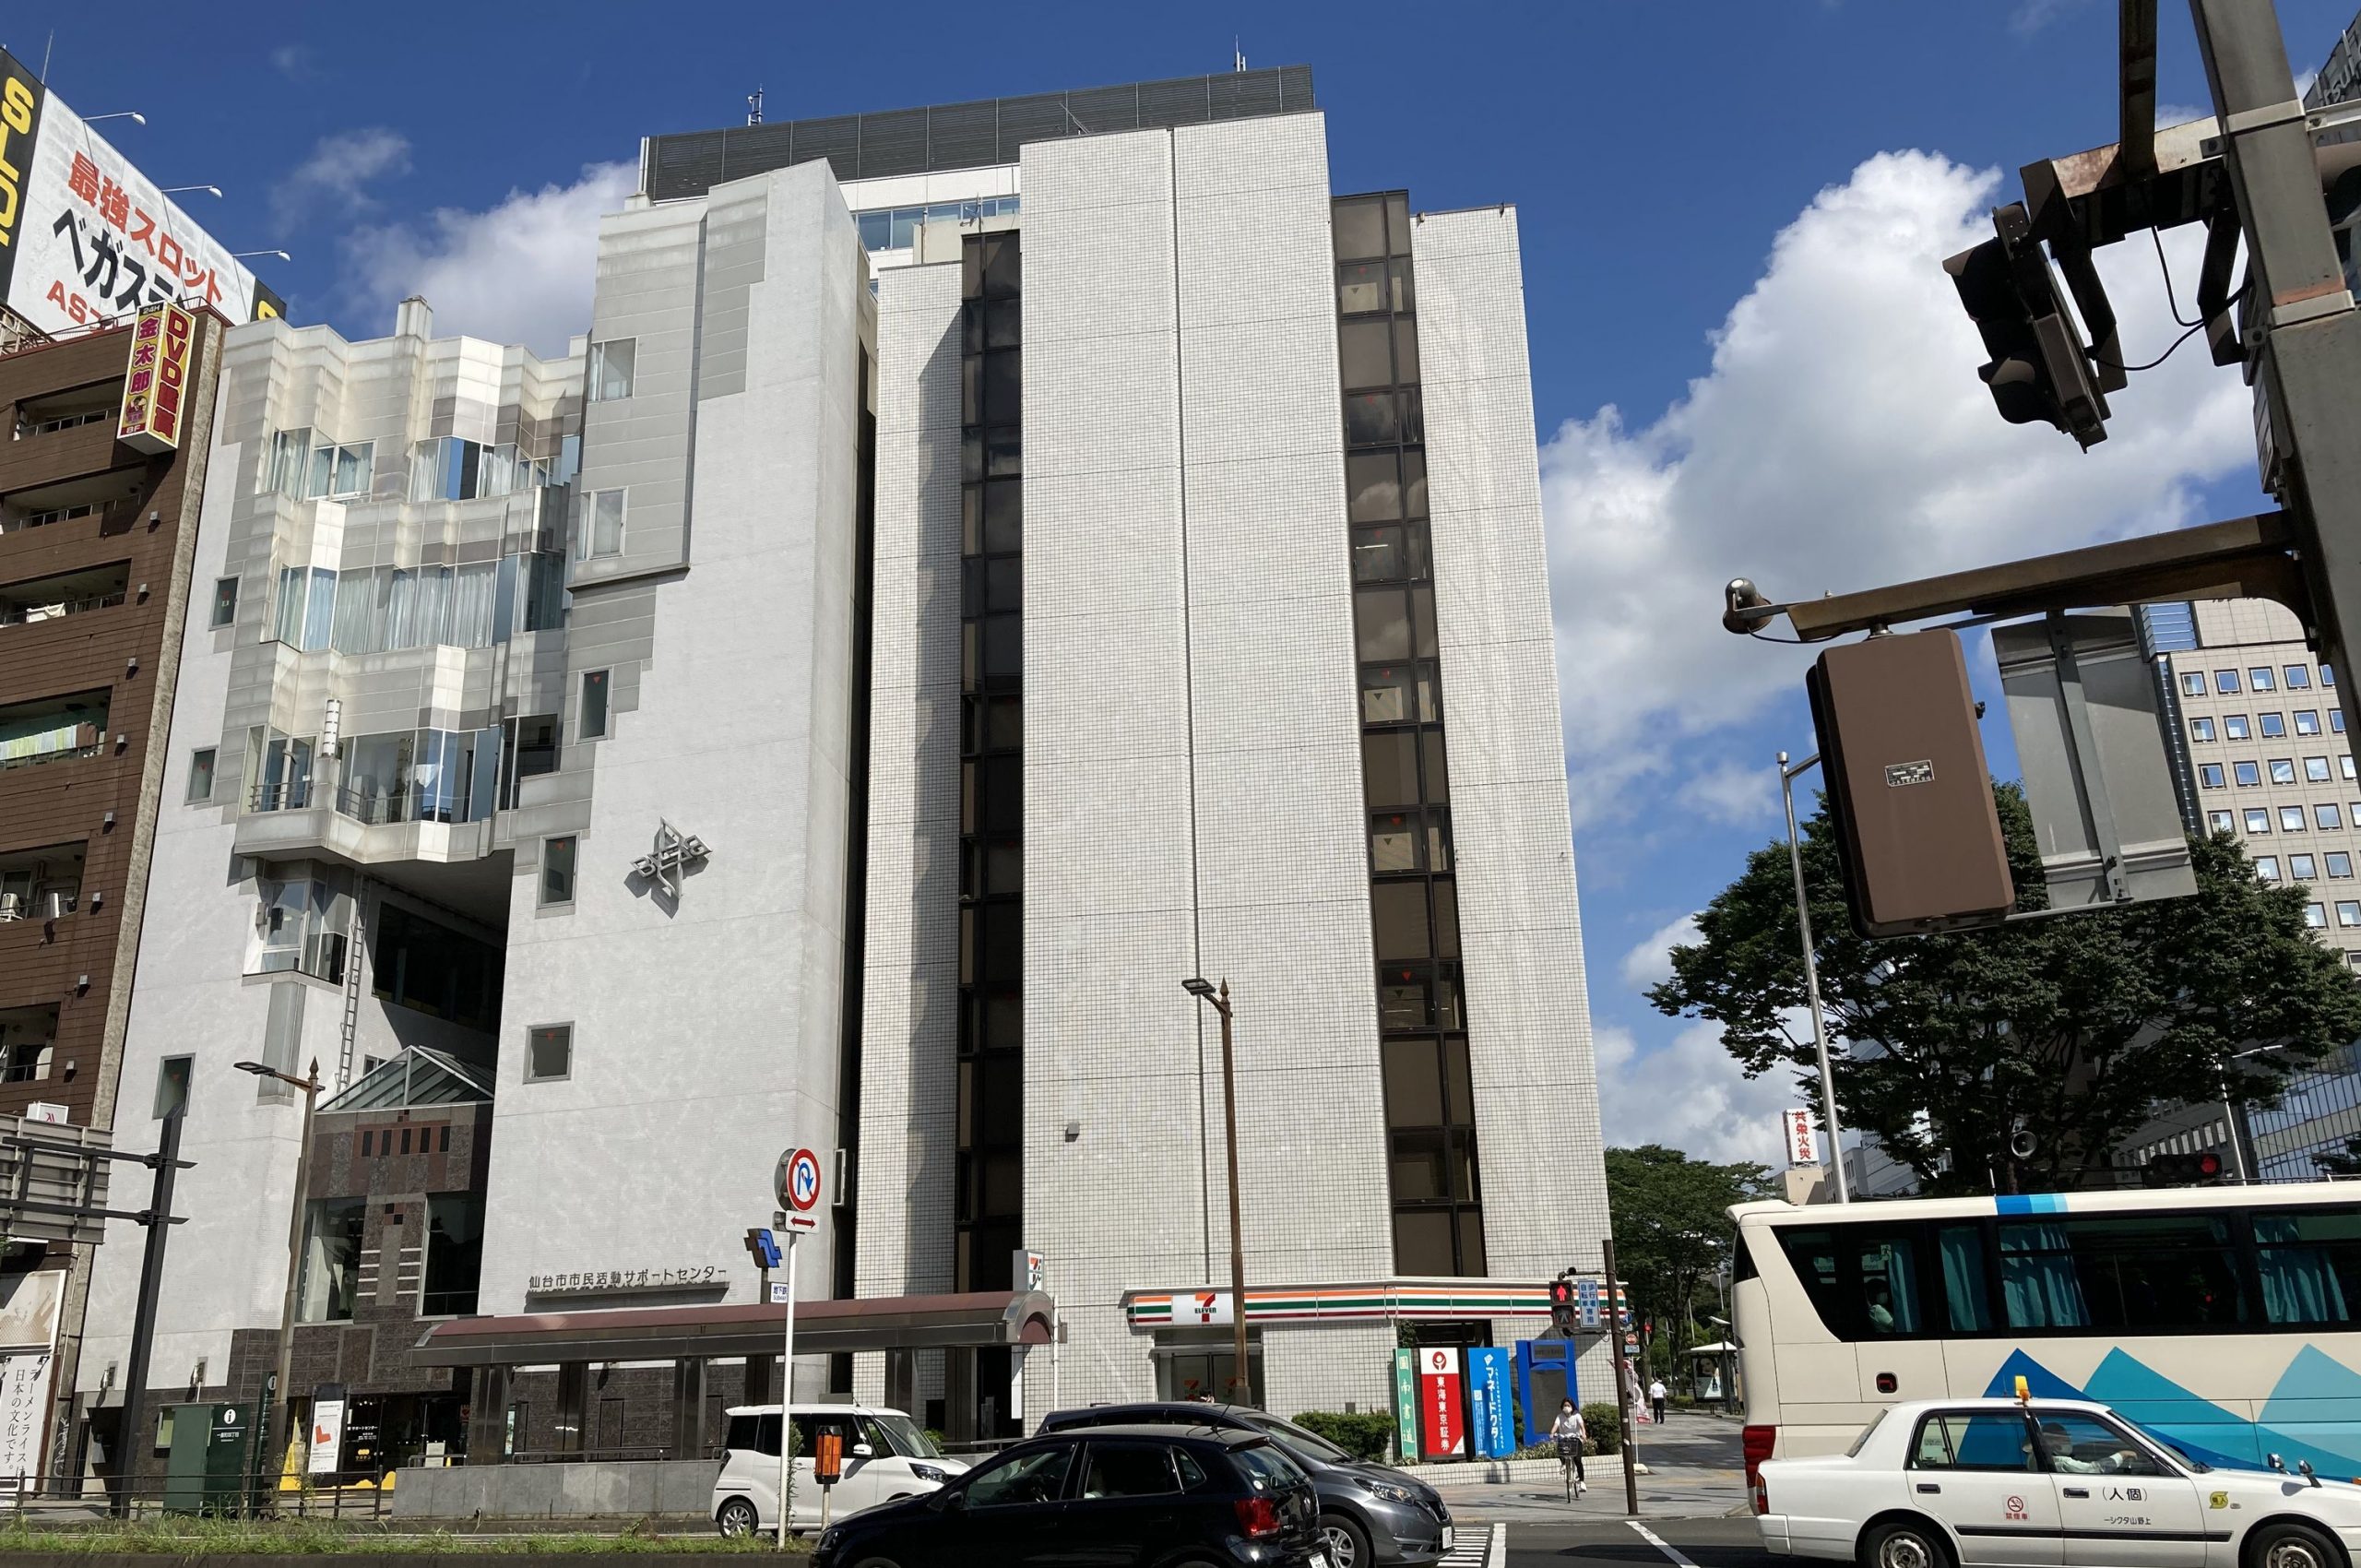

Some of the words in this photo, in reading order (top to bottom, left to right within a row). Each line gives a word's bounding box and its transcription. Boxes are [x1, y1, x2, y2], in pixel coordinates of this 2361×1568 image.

[68, 150, 222, 303] 最強スロット
[129, 316, 160, 395] 金太郎
[1794, 1111, 1811, 1160] 共栄火災
[528, 1265, 727, 1289] 仙台市市民活動サポートセンター
[4, 1369, 26, 1470] 日本の文化です。
[1436, 1376, 1450, 1451] 東海東京証券
[1485, 1367, 1499, 1450] マネードクター
